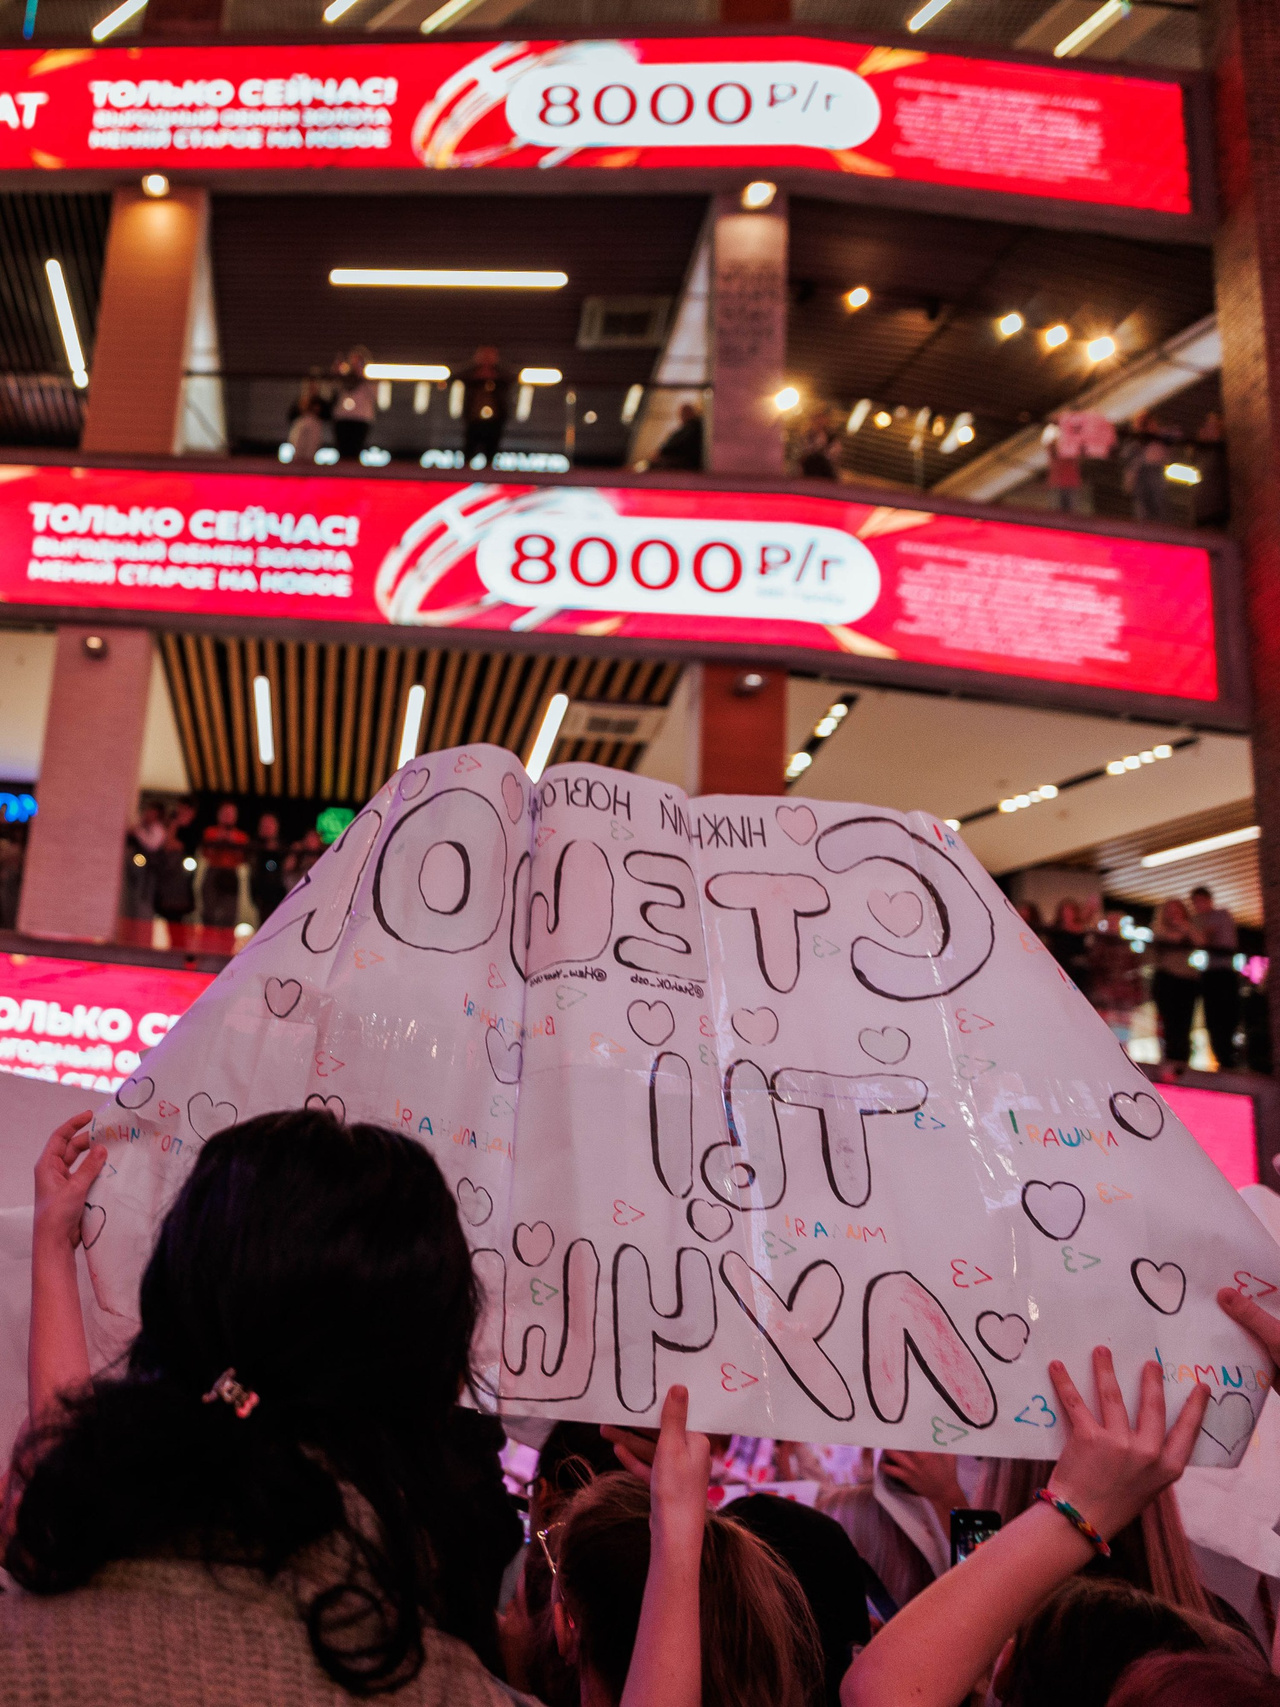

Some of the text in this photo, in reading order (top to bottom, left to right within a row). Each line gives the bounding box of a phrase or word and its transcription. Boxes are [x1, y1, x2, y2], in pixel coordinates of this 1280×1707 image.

[89, 73, 399, 108] ТОЛЬКО СЕЙЧАС!
[28, 502, 360, 546] ТОЛЬКО СЕЙЧАС!
